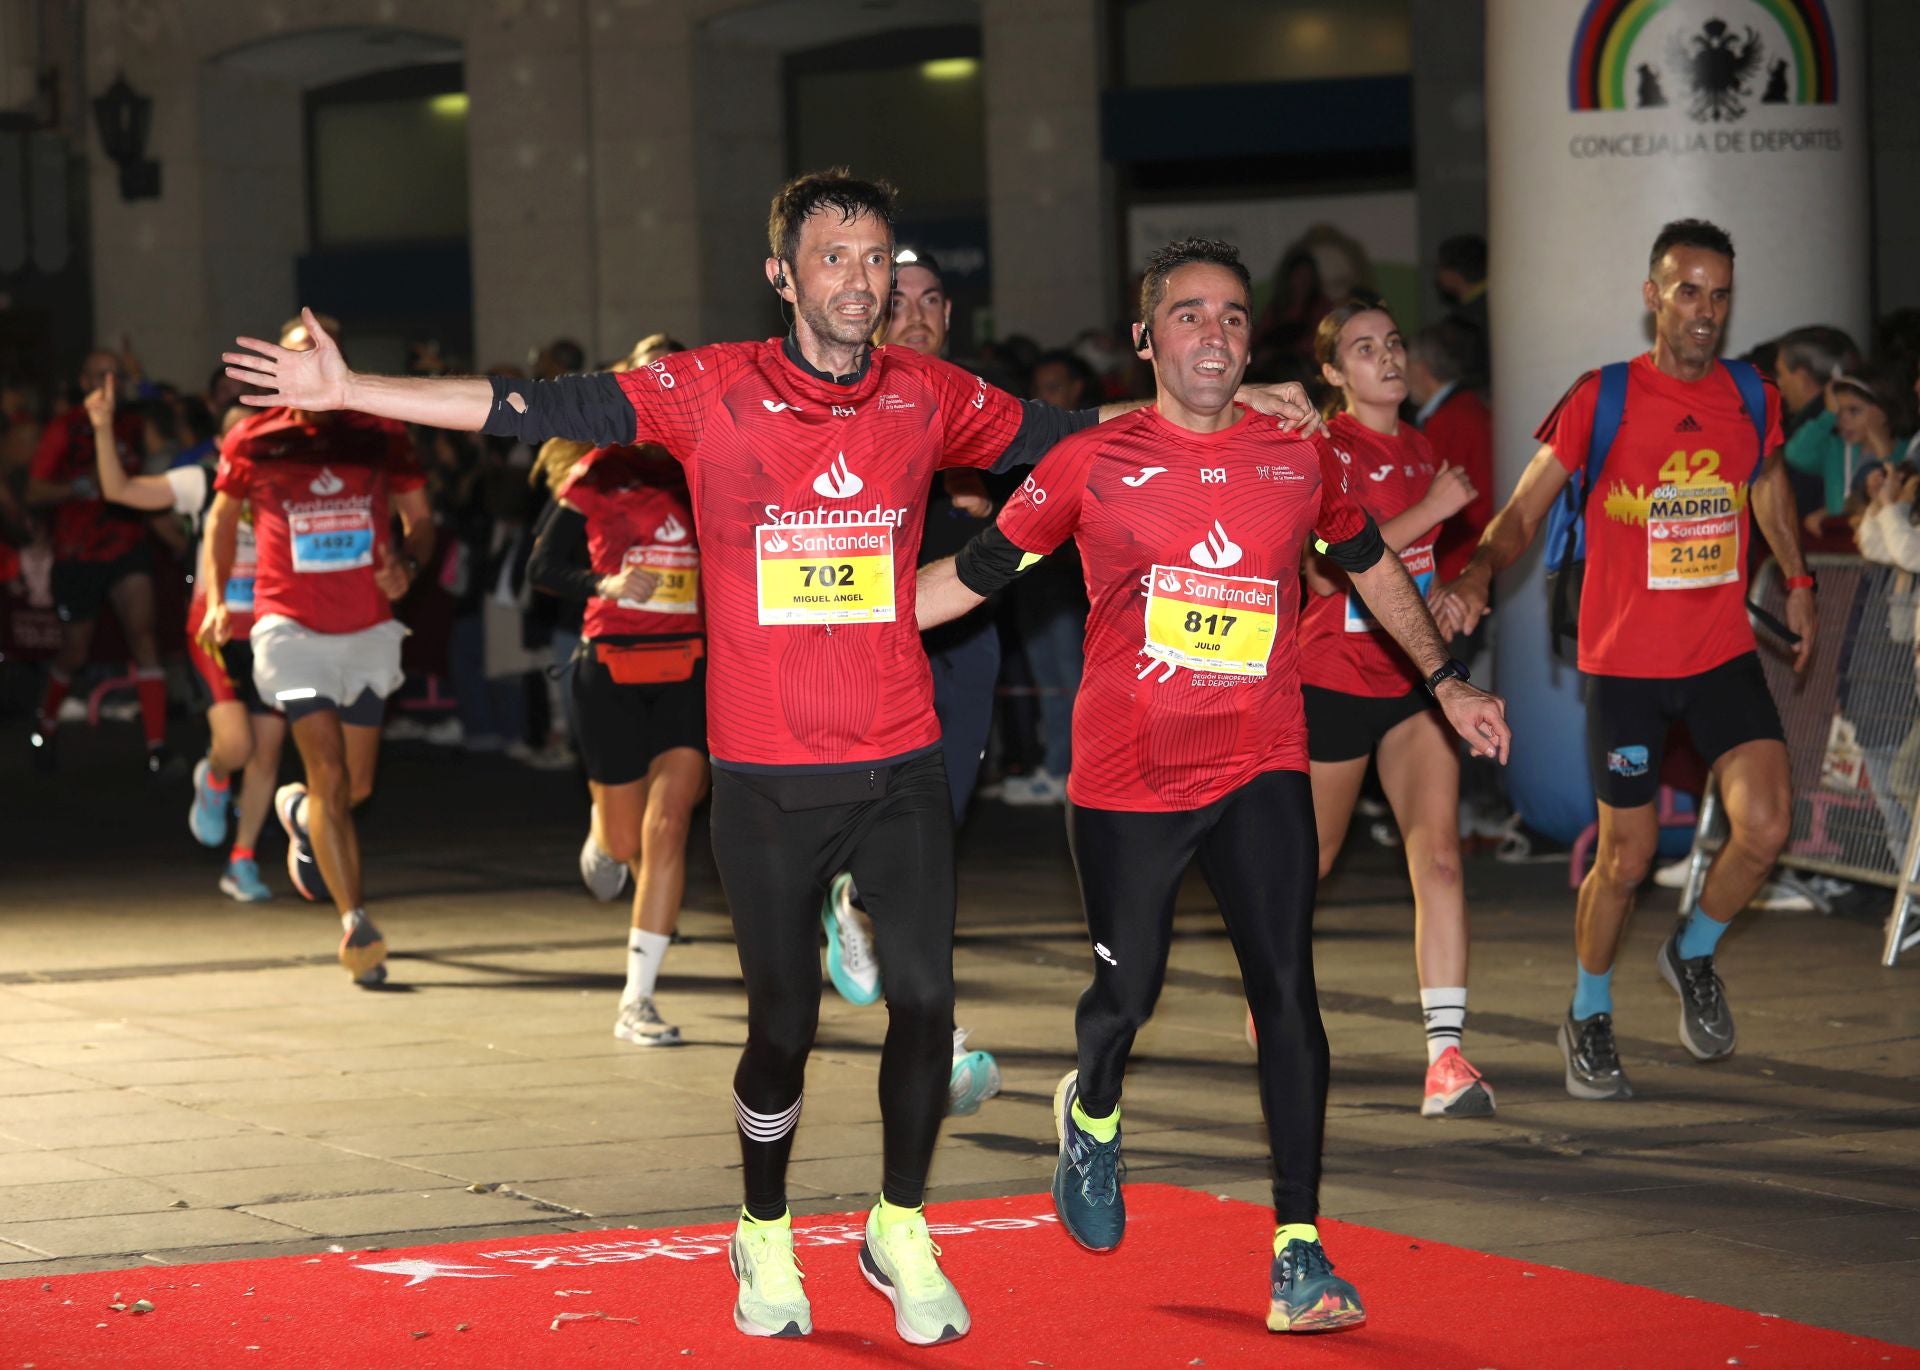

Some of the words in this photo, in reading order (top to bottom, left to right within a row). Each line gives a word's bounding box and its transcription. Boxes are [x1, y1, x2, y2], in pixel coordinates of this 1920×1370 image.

[1714, 129, 1746, 154] DE
[1751, 127, 1842, 152] DEPORTES
[1659, 449, 1720, 483] 42
[1650, 498, 1732, 517] MADRID
[791, 532, 887, 552] Santander
[800, 564, 855, 588] 702
[793, 595, 831, 603] MIGUEL
[834, 594, 864, 602] ANGEL
[1184, 578, 1272, 607] Santander
[1184, 610, 1238, 637] 817
[1194, 642, 1221, 651] JULIO
